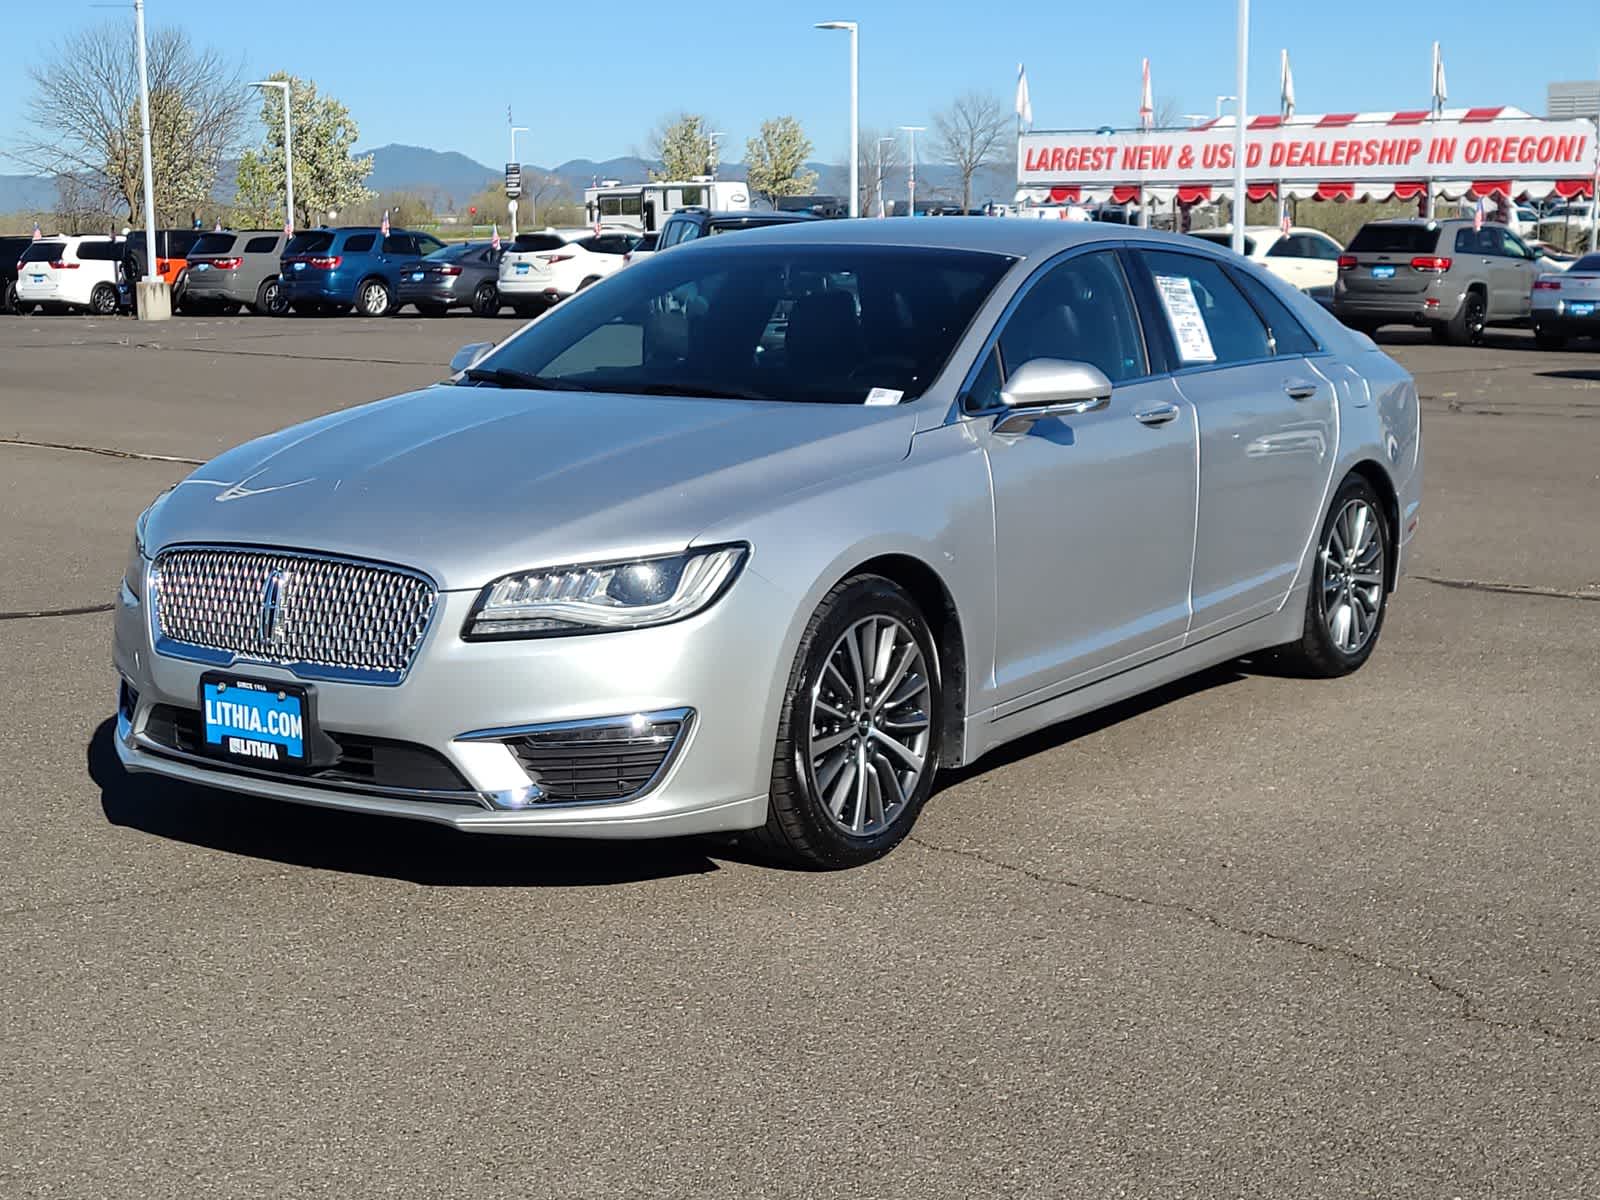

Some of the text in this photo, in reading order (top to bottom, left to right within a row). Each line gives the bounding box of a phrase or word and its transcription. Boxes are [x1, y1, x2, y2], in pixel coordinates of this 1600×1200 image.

[1025, 135, 1587, 171] LARGEST NEW & USD DEALERSHIP IN OREGON!
[205, 699, 303, 740] LITHIA.COM
[241, 739, 279, 760] LITHIA
